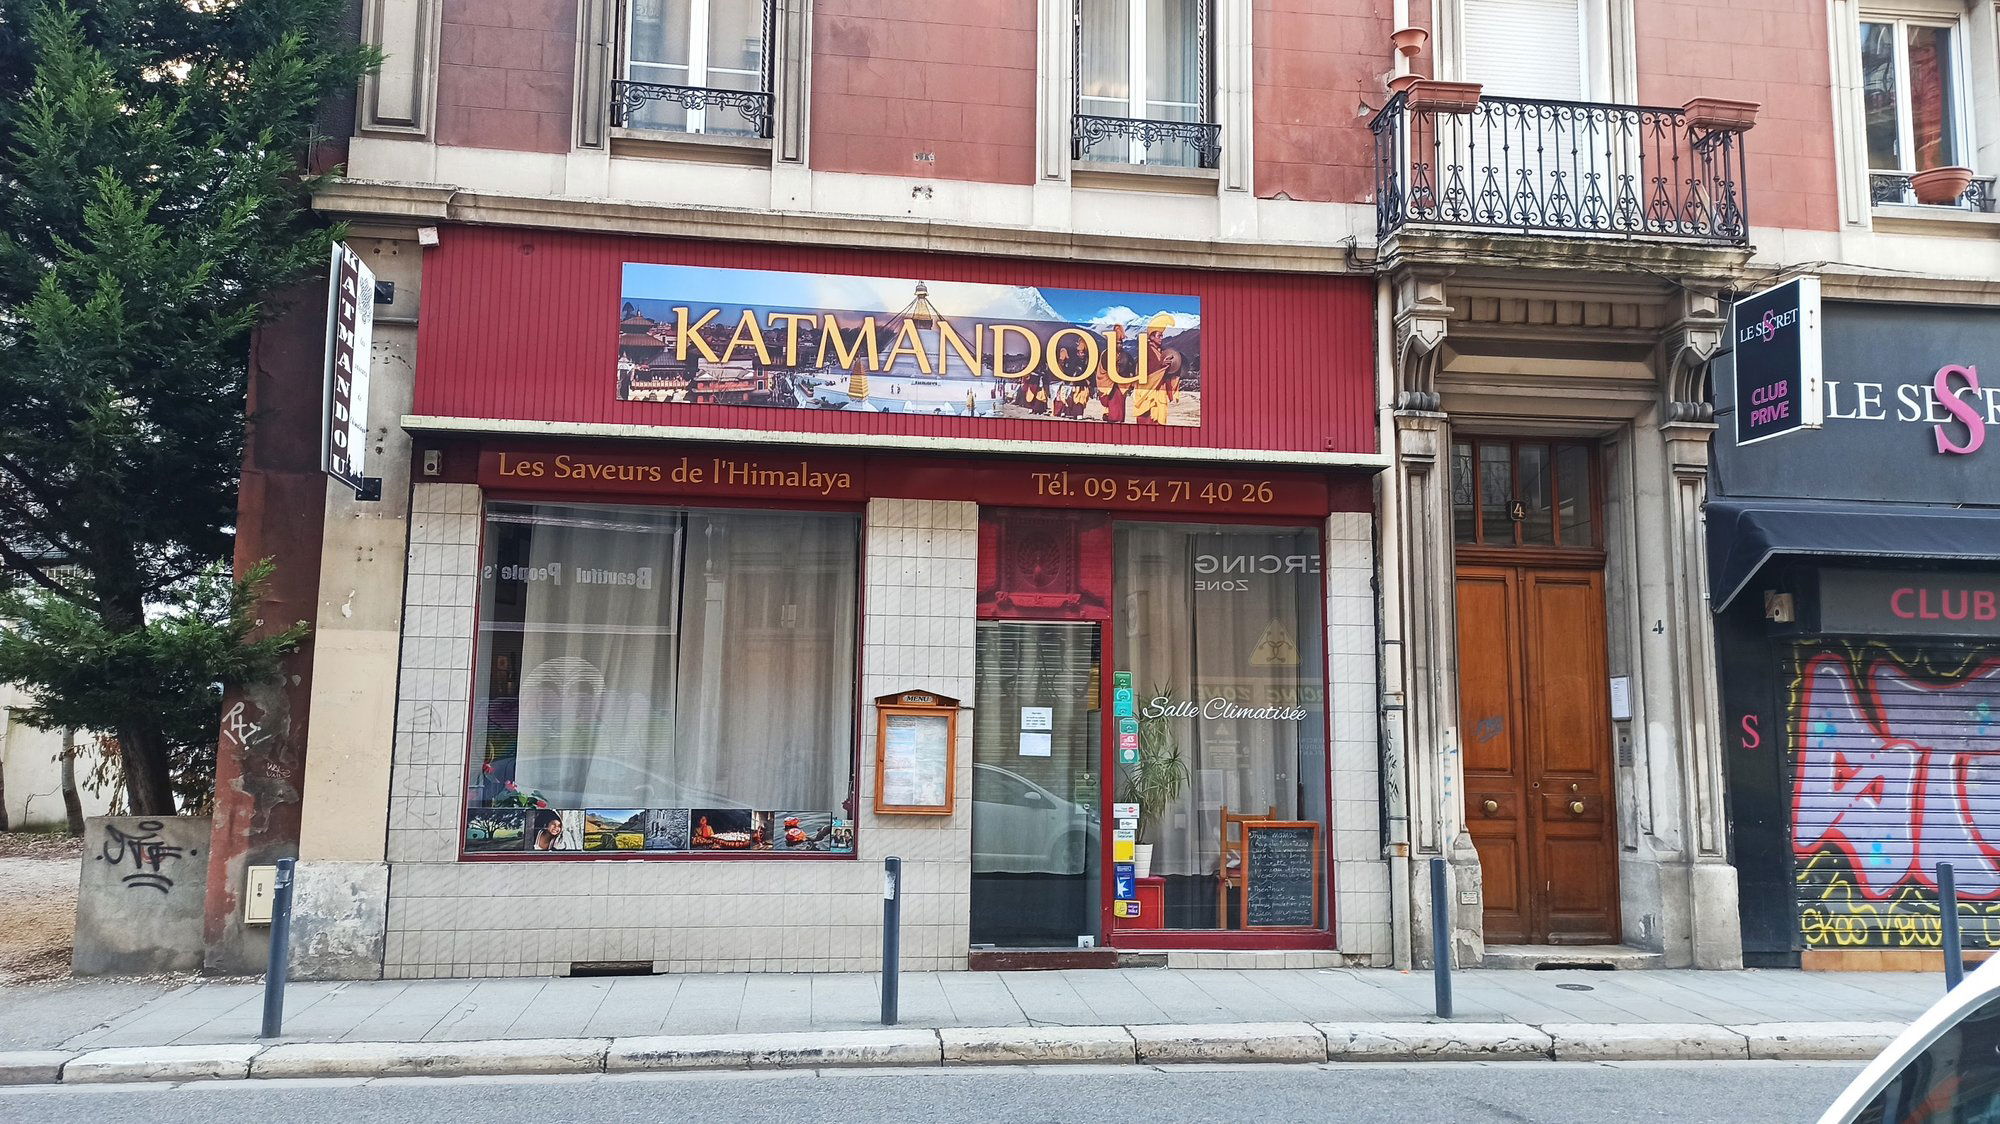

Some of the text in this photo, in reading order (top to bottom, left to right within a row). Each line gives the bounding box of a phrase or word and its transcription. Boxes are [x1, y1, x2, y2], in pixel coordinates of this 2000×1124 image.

[672, 306, 1151, 385] KATMANDOU
[1740, 325, 1755, 342] LE
[332, 248, 360, 476] KATMANDOU
[1751, 379, 1788, 406] CLUB
[1824, 380, 1887, 421] LE
[1750, 400, 1790, 428] PRIVE
[498, 452, 852, 496] Les Saveurs de l'Himalaya
[1031, 471, 1274, 504] Tél. 09 54 71 40 26
[1512, 502, 1525, 519] 4
[1890, 588, 1997, 621] CLUB
[1652, 619, 1665, 635] 4
[906, 694, 931, 703] MENU
[1142, 696, 1308, 721] Salle Climatisée
[1741, 714, 1760, 750] S
